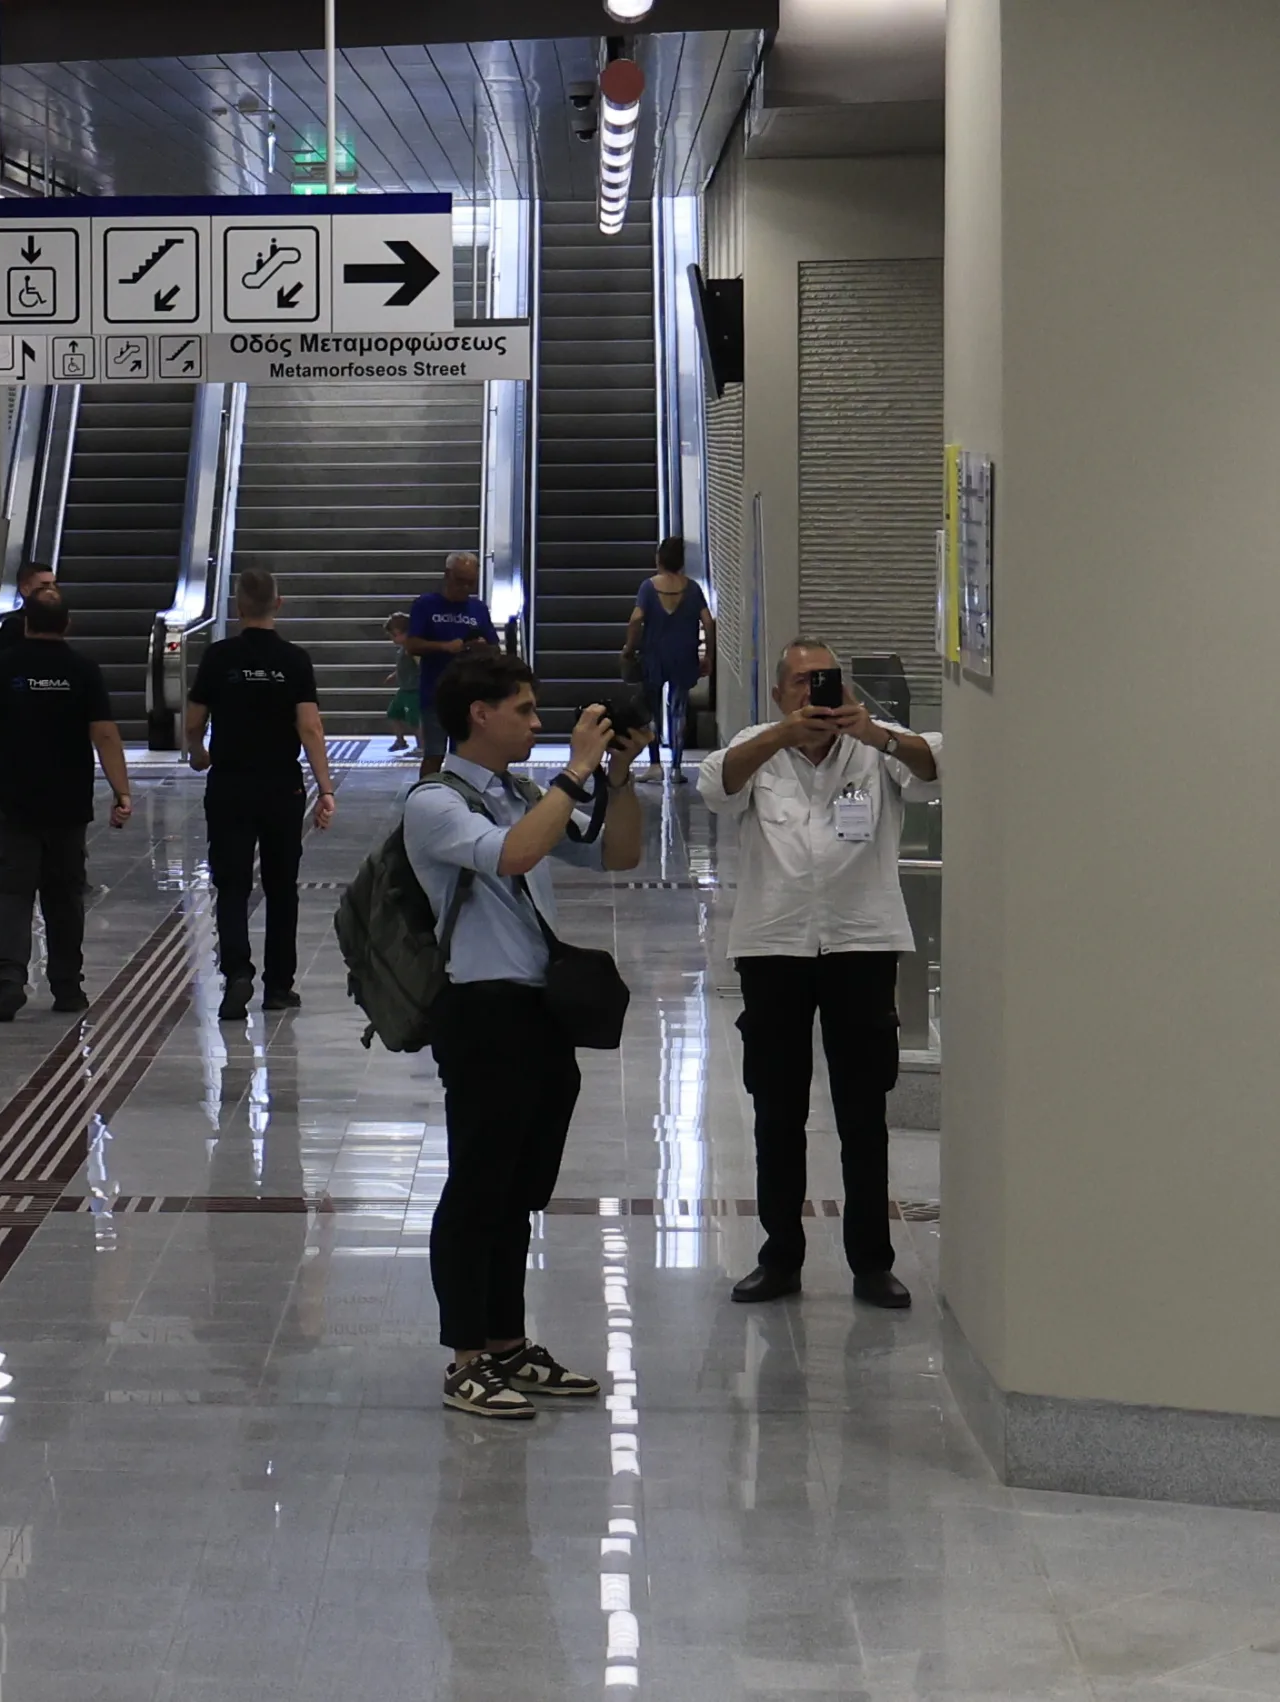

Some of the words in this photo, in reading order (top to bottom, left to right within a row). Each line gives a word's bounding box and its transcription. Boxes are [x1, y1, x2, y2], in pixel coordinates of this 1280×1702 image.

[230, 333, 292, 358] Οδός
[300, 332, 507, 356] Μεταμορφώσεως
[270, 361, 408, 378] Metamorfoseos
[413, 361, 467, 376] Street
[27, 678, 70, 687] THEMA
